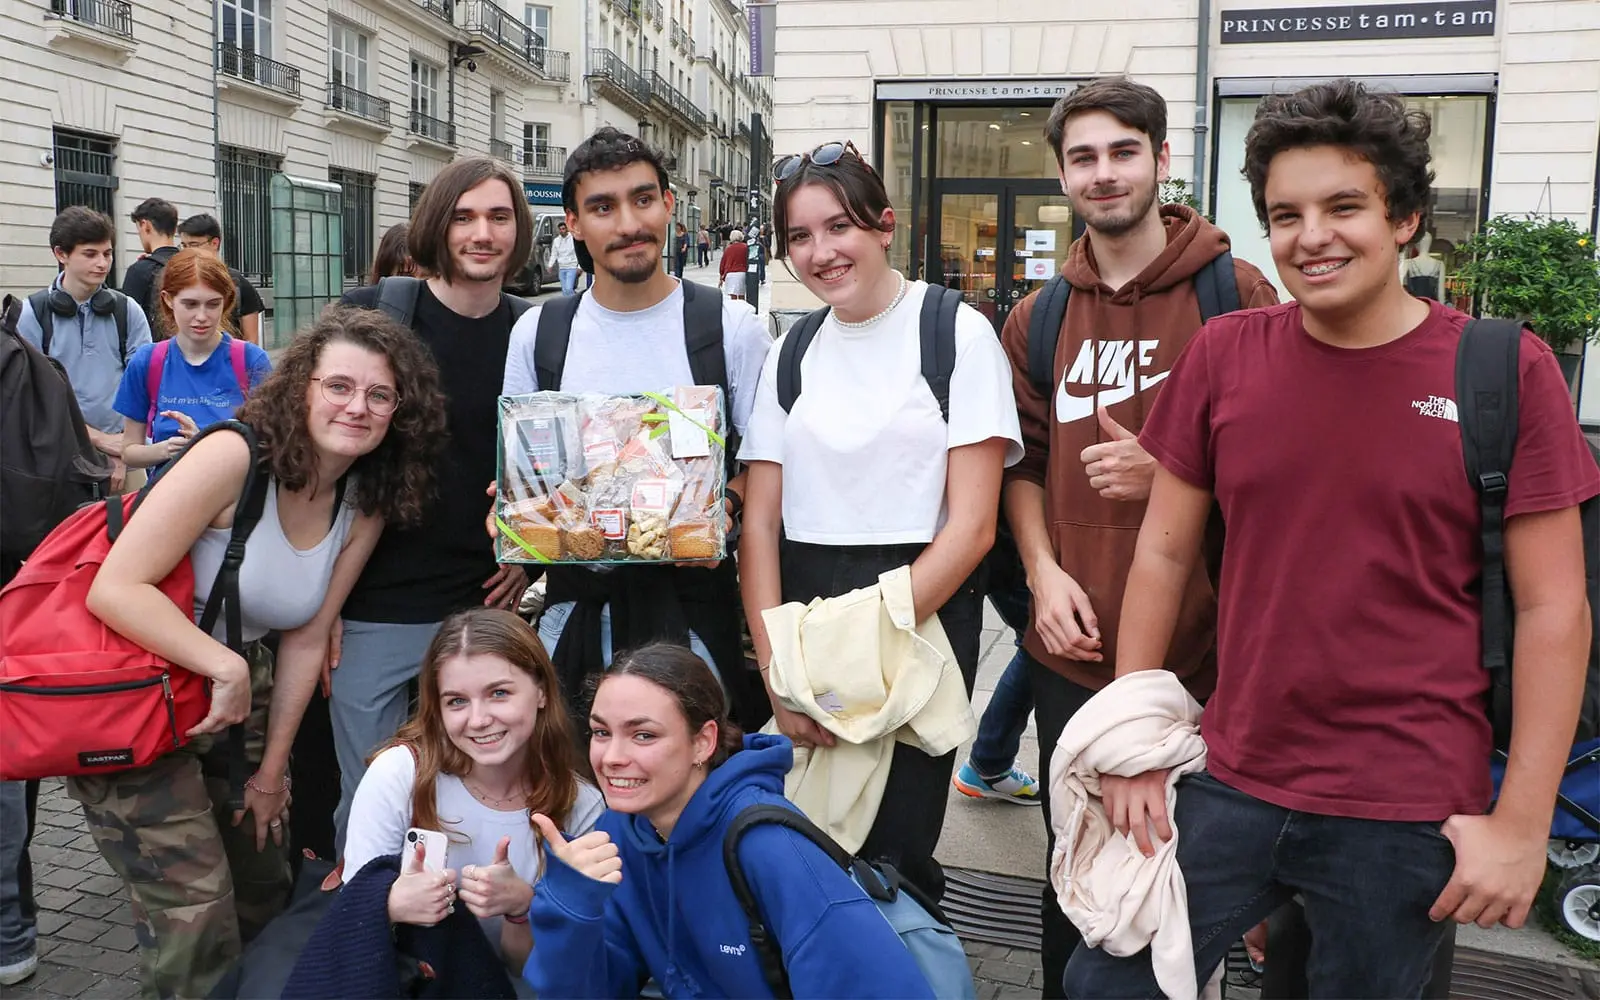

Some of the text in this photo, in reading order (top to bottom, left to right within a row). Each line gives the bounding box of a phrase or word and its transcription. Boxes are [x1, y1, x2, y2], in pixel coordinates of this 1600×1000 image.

[1223, 16, 1351, 33] PRINCESSE
[929, 87, 988, 95] PRINCESSE
[1066, 339, 1160, 386] NIKE
[1428, 395, 1446, 404] THE
[1411, 400, 1445, 412] NORTH
[1419, 408, 1444, 418] FACE
[87, 754, 126, 763] EASTPAK
